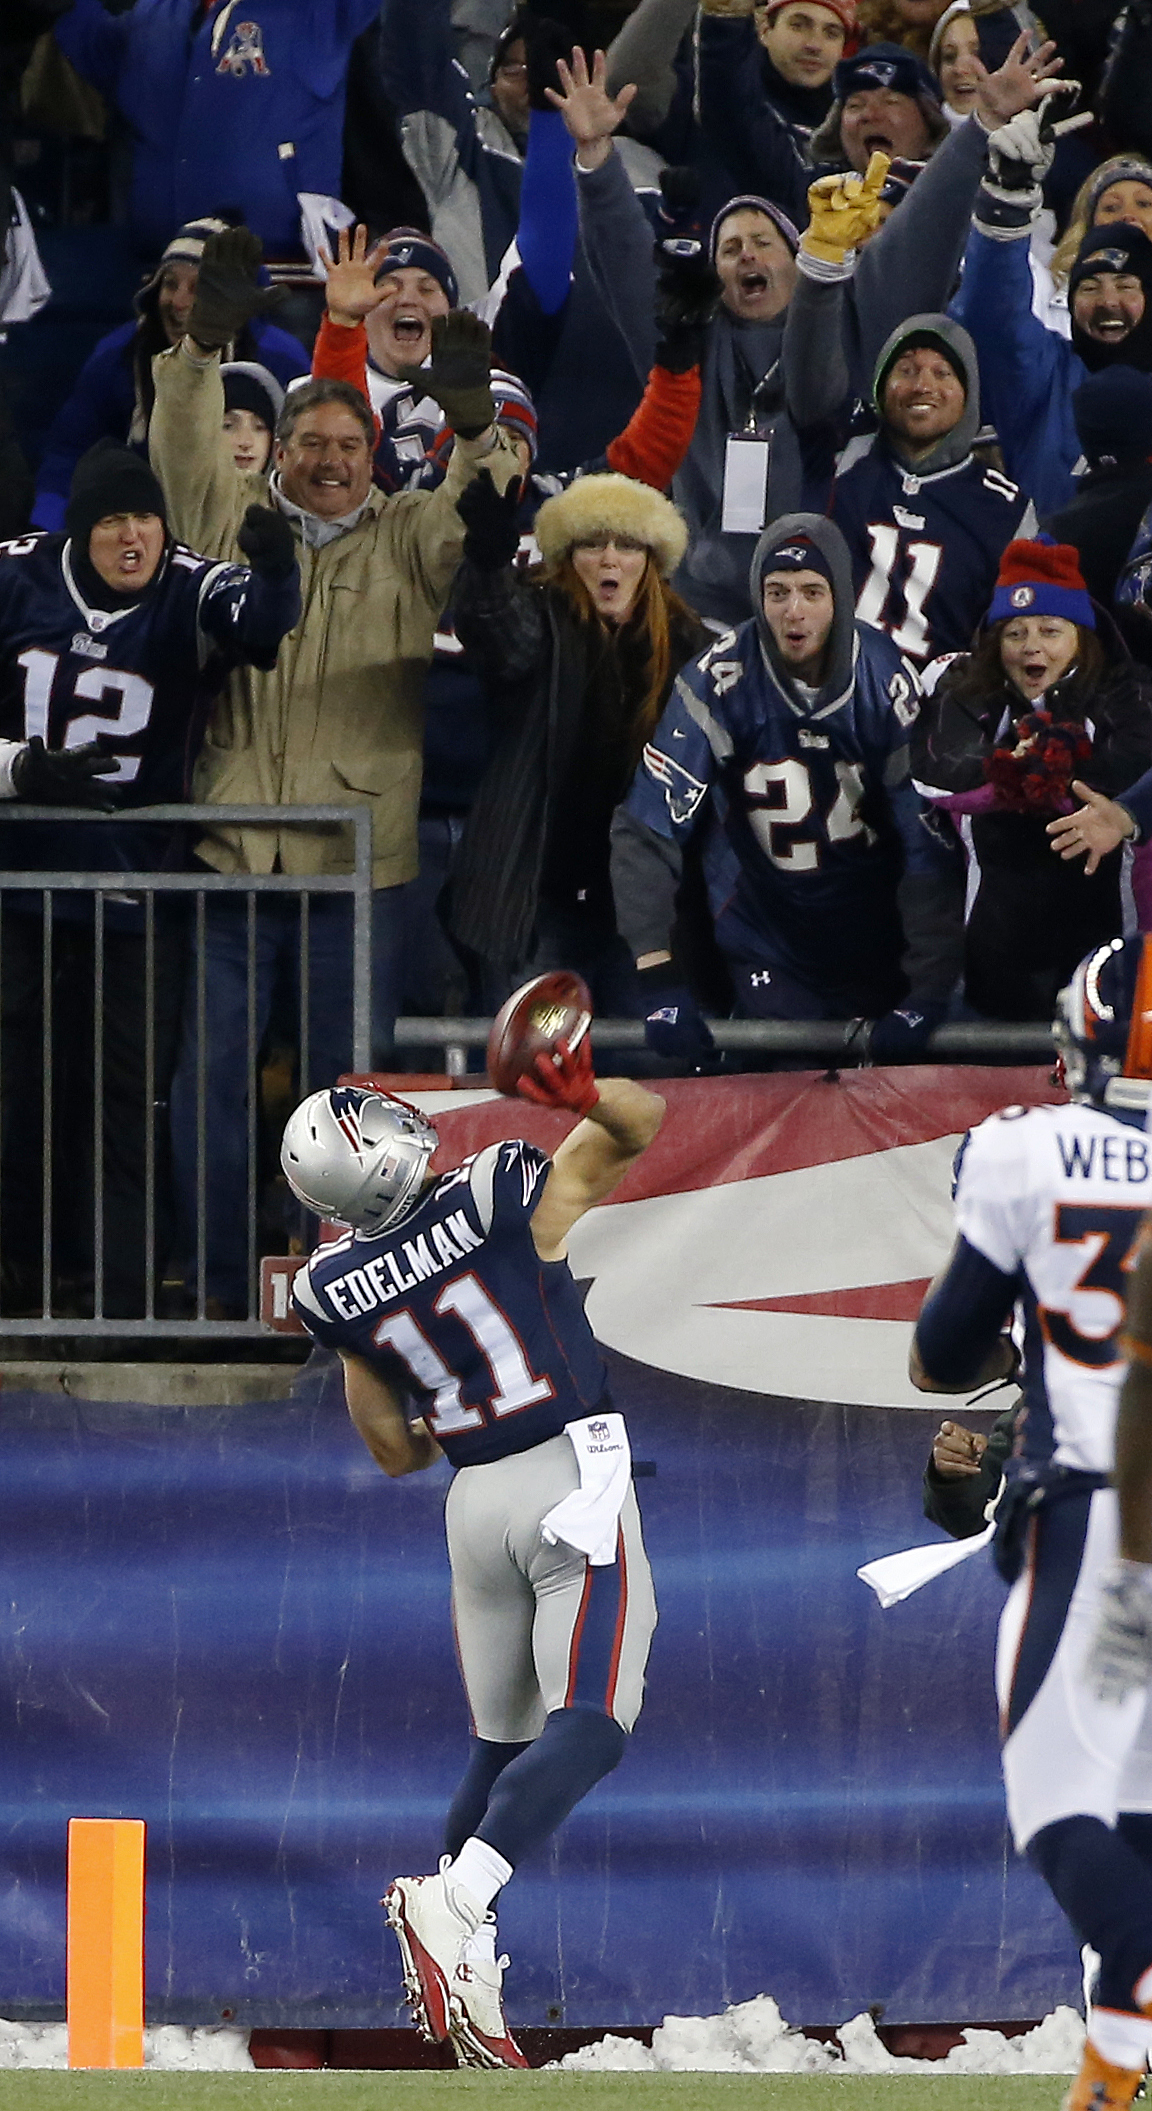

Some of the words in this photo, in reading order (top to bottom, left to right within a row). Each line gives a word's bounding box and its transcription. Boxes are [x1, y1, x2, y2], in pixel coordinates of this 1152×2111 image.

[853, 522, 944, 658] 11
[17, 646, 156, 783] 12
[1055, 1131, 1150, 1183] WEB
[324, 1208, 486, 1321] EDELMAN
[371, 1268, 558, 1437] 11
